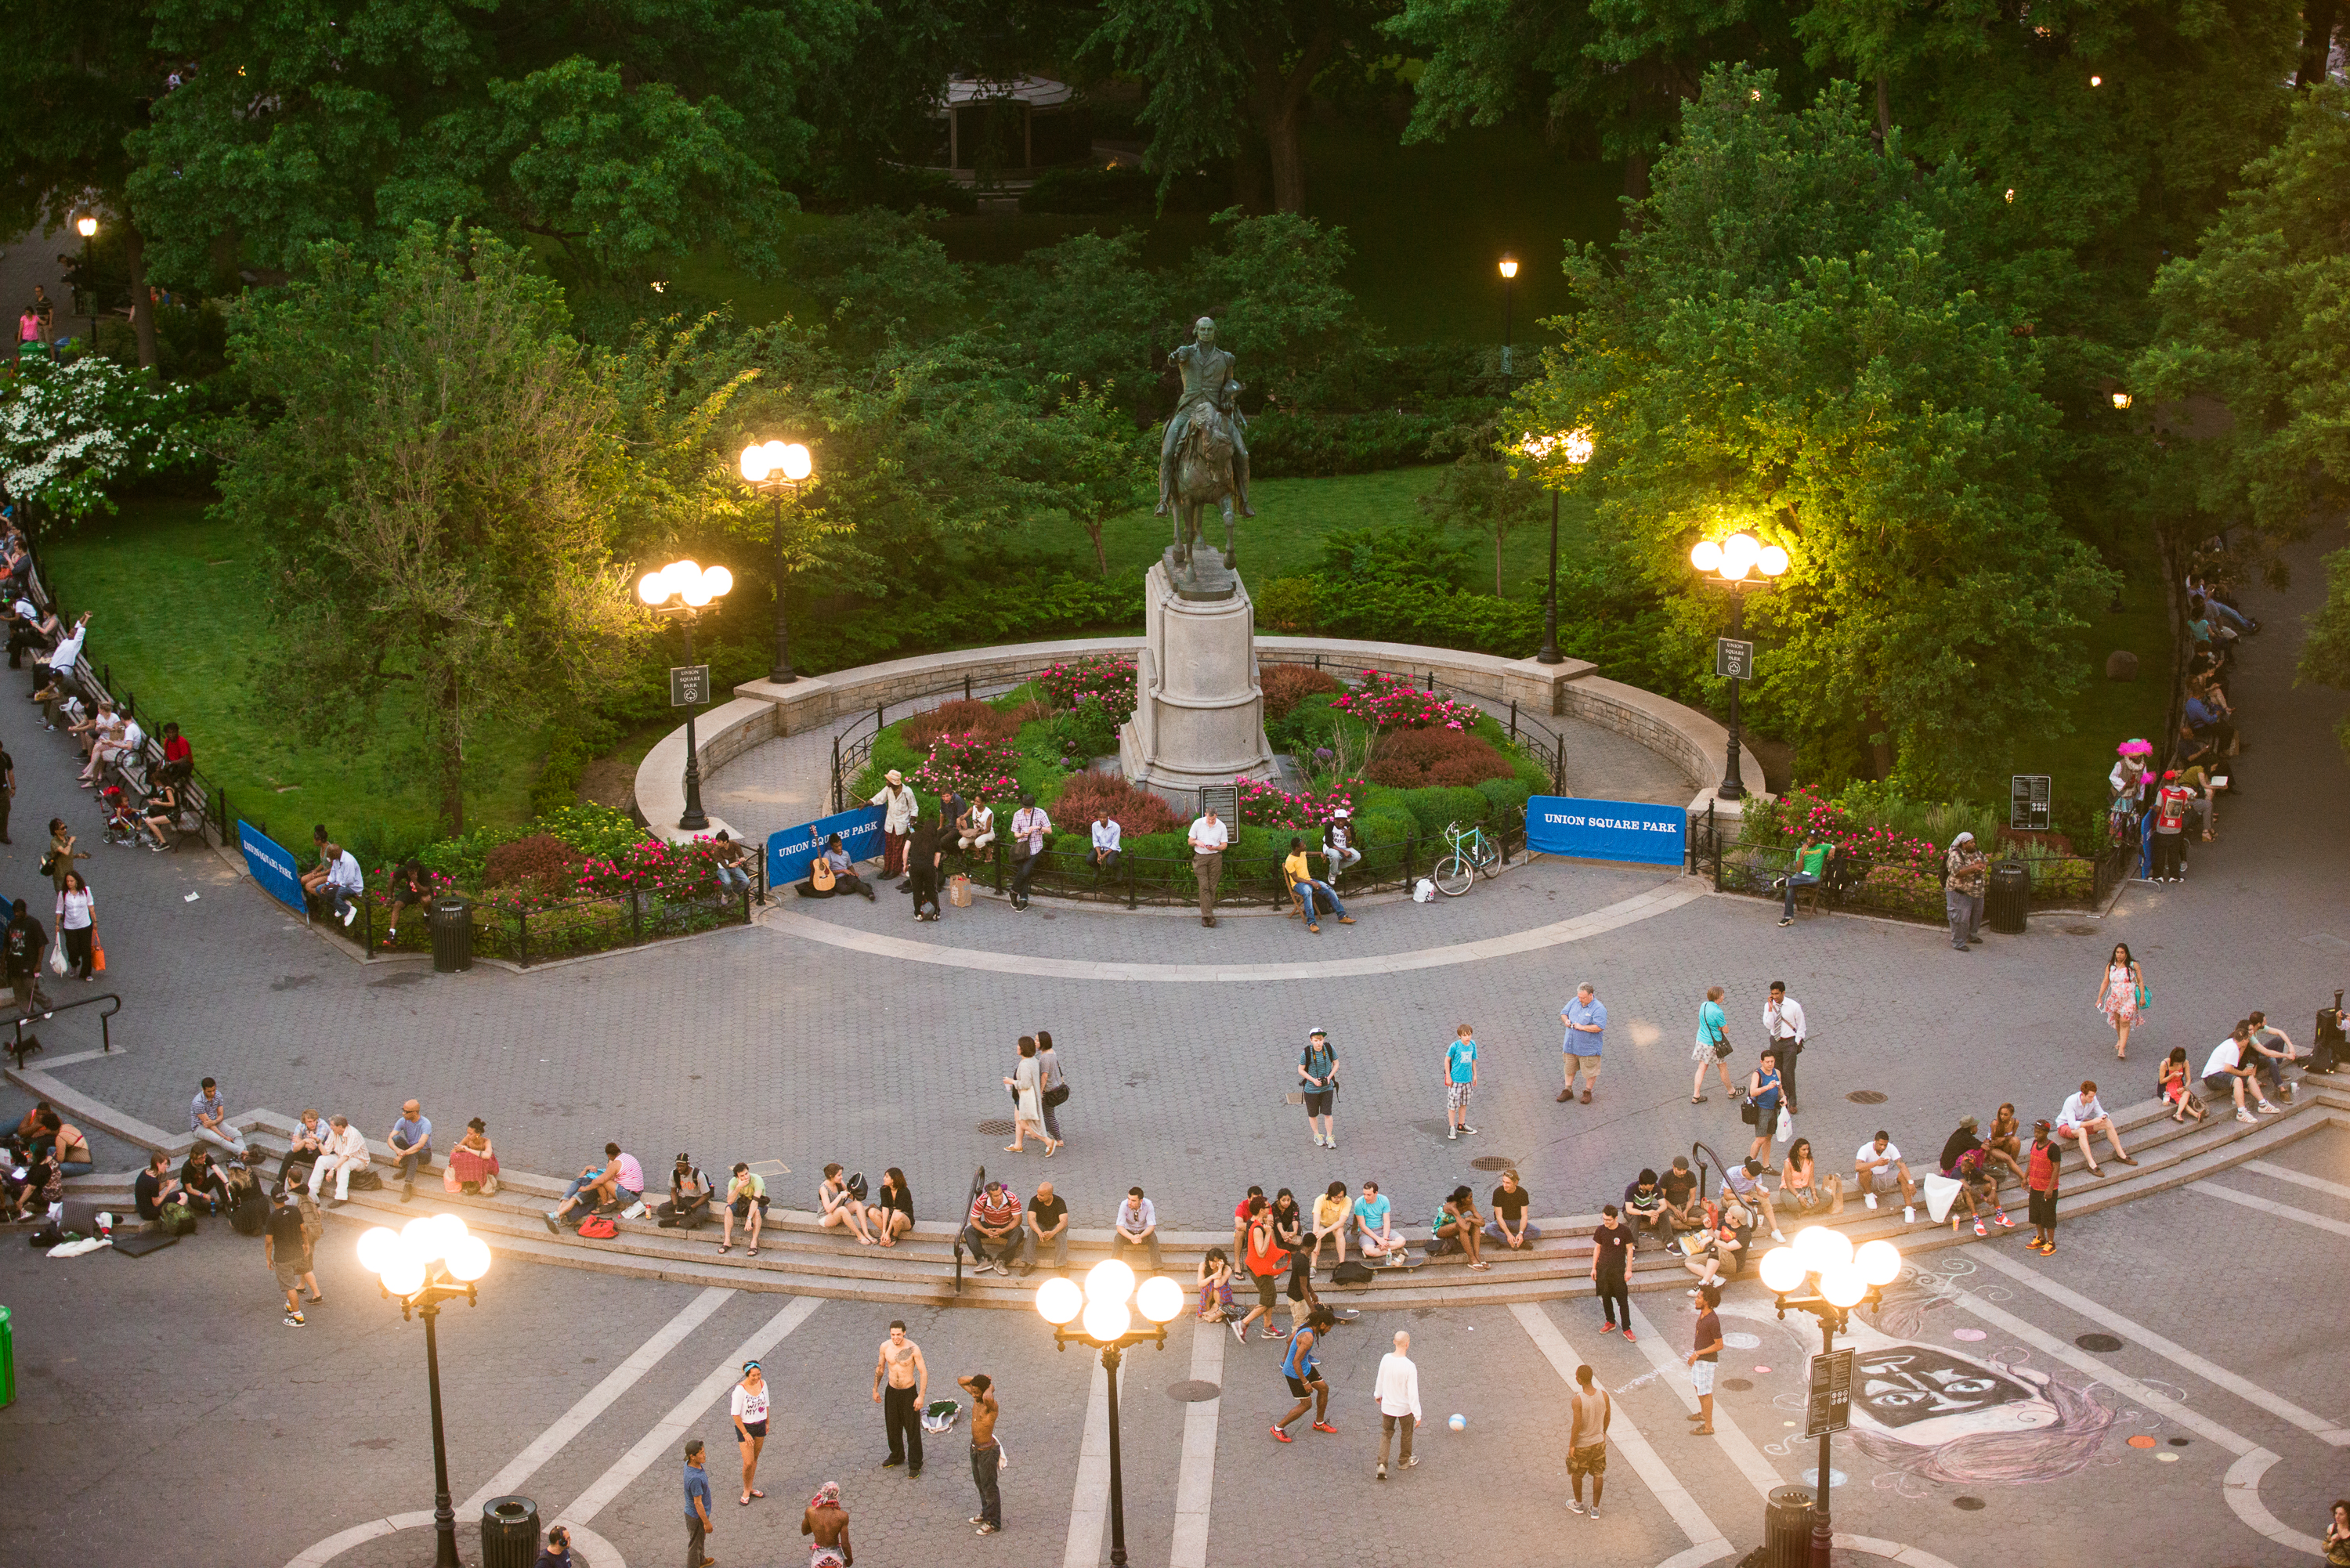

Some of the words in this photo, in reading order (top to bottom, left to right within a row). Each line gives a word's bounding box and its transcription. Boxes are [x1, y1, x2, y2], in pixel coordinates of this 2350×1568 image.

[1544, 813, 1585, 826] UNION
[1589, 818, 1640, 830] SQUARE
[1643, 822, 1676, 833] PARK
[778, 840, 809, 857] UNION
[812, 829, 850, 847] SQURE
[851, 821, 878, 836] PARK
[278, 864, 294, 880] PARK
[747, 1400, 766, 1409] WITH
